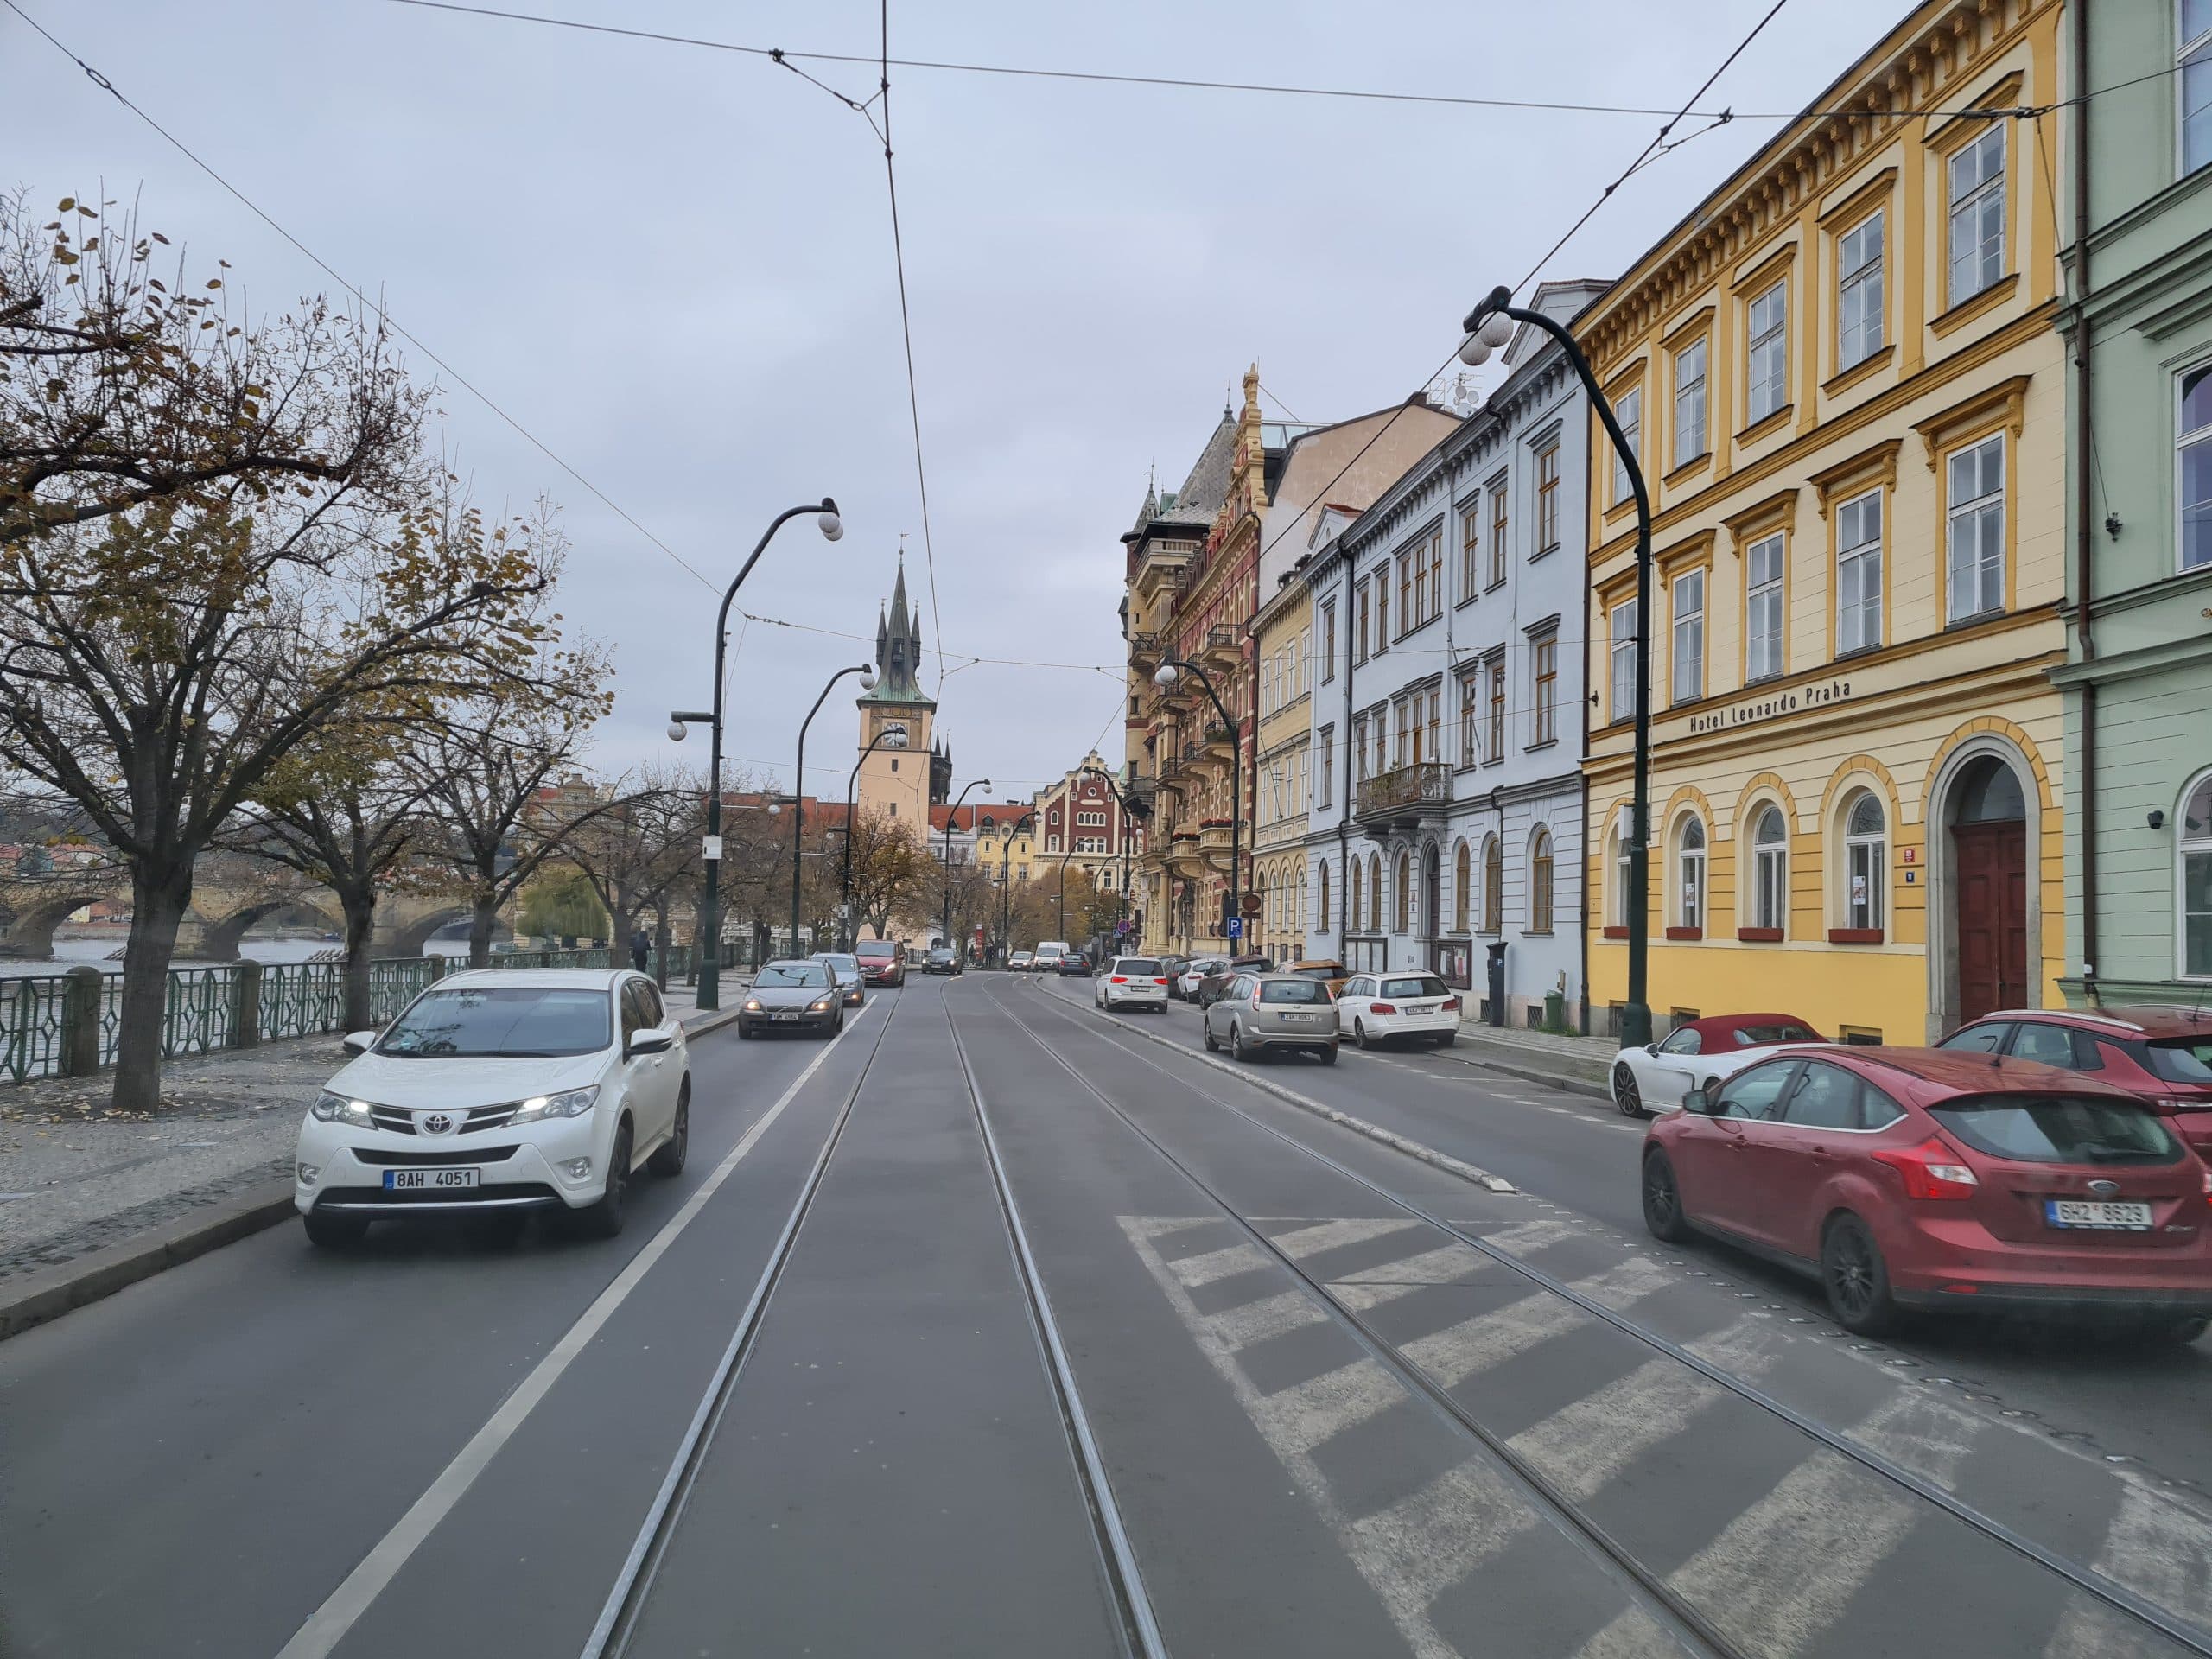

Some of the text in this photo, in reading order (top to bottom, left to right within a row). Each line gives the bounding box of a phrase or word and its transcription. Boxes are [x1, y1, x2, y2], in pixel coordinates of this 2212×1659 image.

[1690, 681, 1850, 732] Hotel Leonardo Praha
[1230, 919, 1239, 931] P
[397, 1171, 471, 1187] 8AH 4051
